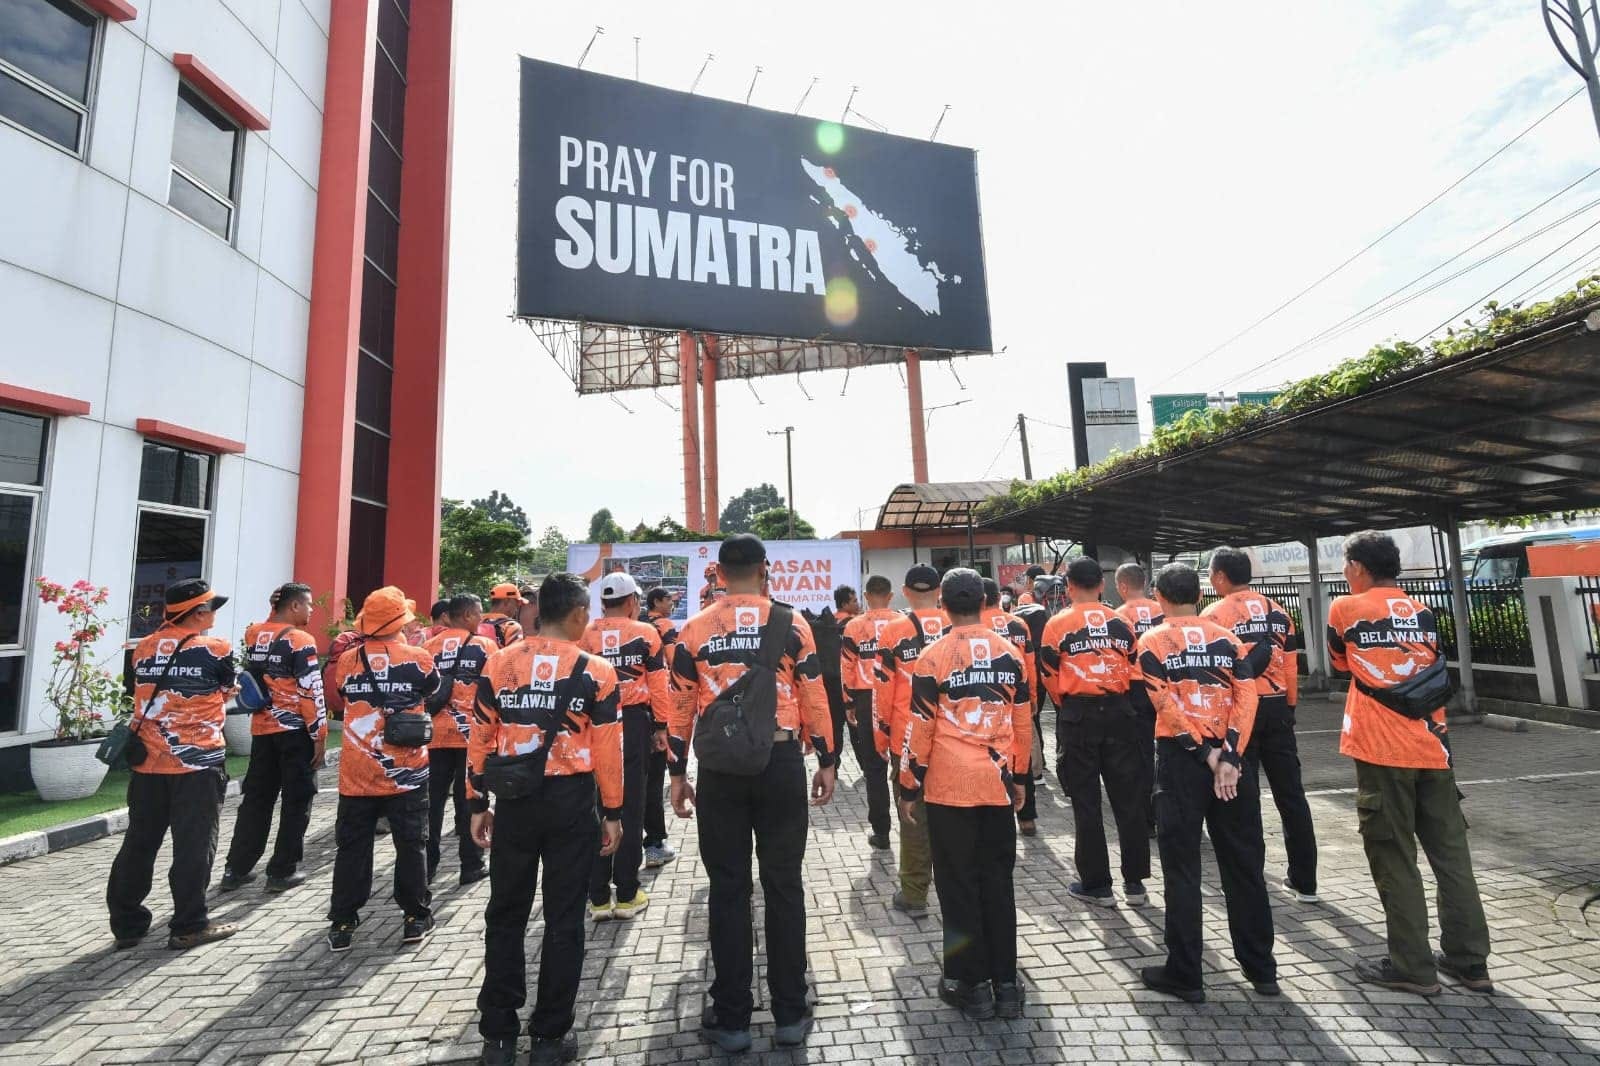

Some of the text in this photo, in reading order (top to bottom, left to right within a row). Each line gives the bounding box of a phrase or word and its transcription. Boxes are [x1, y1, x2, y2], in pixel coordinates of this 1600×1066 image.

[559, 135, 735, 211] PRAY FOR
[554, 195, 827, 296] SUMATRA
[770, 559, 831, 574] ASAN
[770, 575, 831, 591] WAN
[1271, 623, 1286, 633] PKS
[1395, 618, 1417, 626] PKS
[1359, 631, 1425, 644] RELAWAN
[708, 637, 761, 654] RELAWAN
[1070, 638, 1112, 653] RELAWAN
[460, 660, 477, 668] PKS
[624, 655, 643, 666] PKS
[1165, 655, 1233, 670] RELAWAN PKS
[179, 666, 203, 677] PKS
[998, 671, 1016, 685] PKS
[391, 682, 413, 692] PKS
[534, 680, 551, 689] PKS
[499, 694, 585, 711] RELAWAN KS
